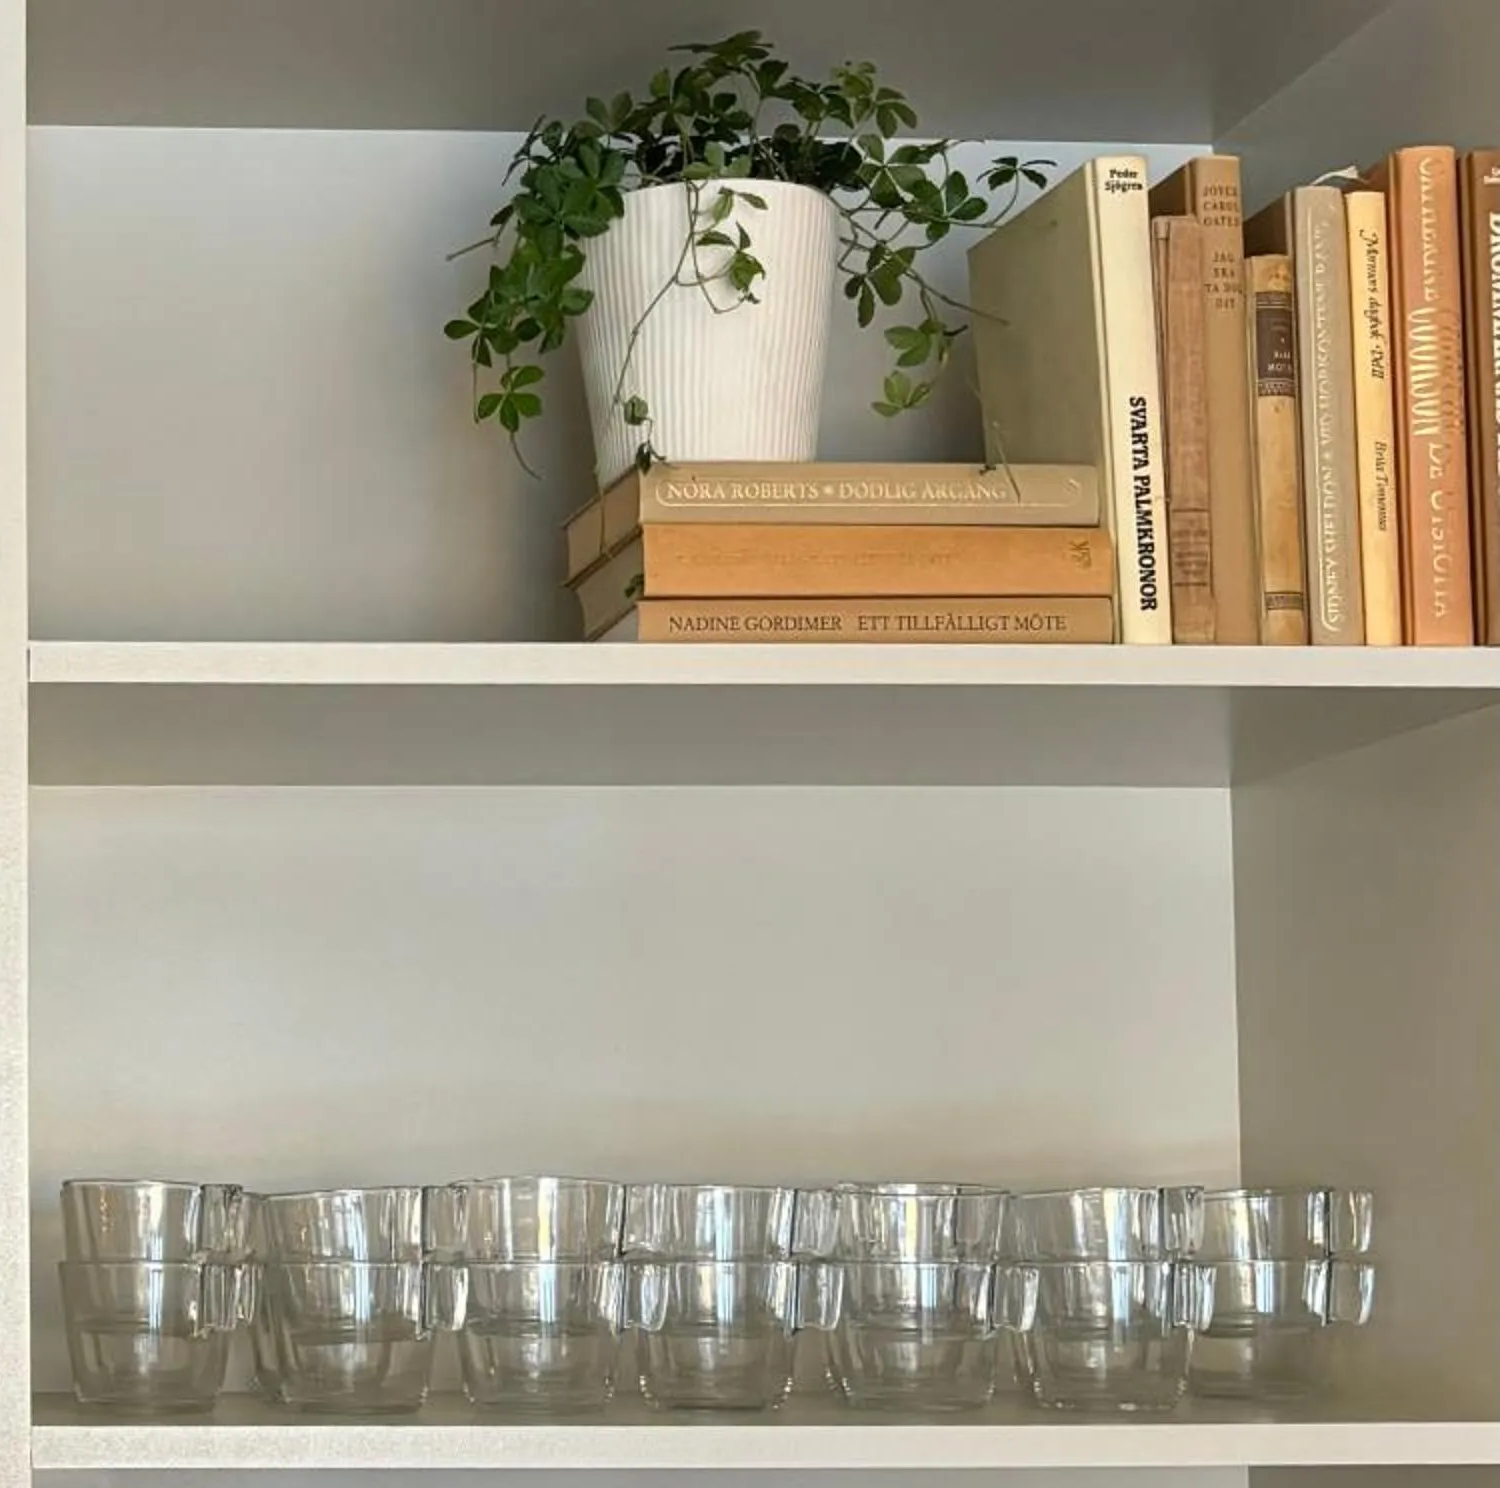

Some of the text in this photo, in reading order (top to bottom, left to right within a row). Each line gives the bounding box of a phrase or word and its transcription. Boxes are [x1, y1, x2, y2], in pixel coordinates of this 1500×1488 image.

[1203, 186, 1238, 197] JOYCE
[1203, 217, 1239, 227] OATES
[1419, 156, 1444, 302] CATHERINE
[1408, 307, 1457, 436] COOKSON
[1429, 442, 1451, 479] DE
[667, 482, 725, 500] NORA
[730, 482, 818, 500] ROBERTS
[1129, 396, 1158, 611] SVARTA PALMKRONOR
[1320, 466, 1337, 553] SHELDON
[1325, 559, 1343, 625] SIDNEY
[668, 612, 1067, 632] NADINE GORDIMER ETT TILLFÄLLIGT MÖTE
